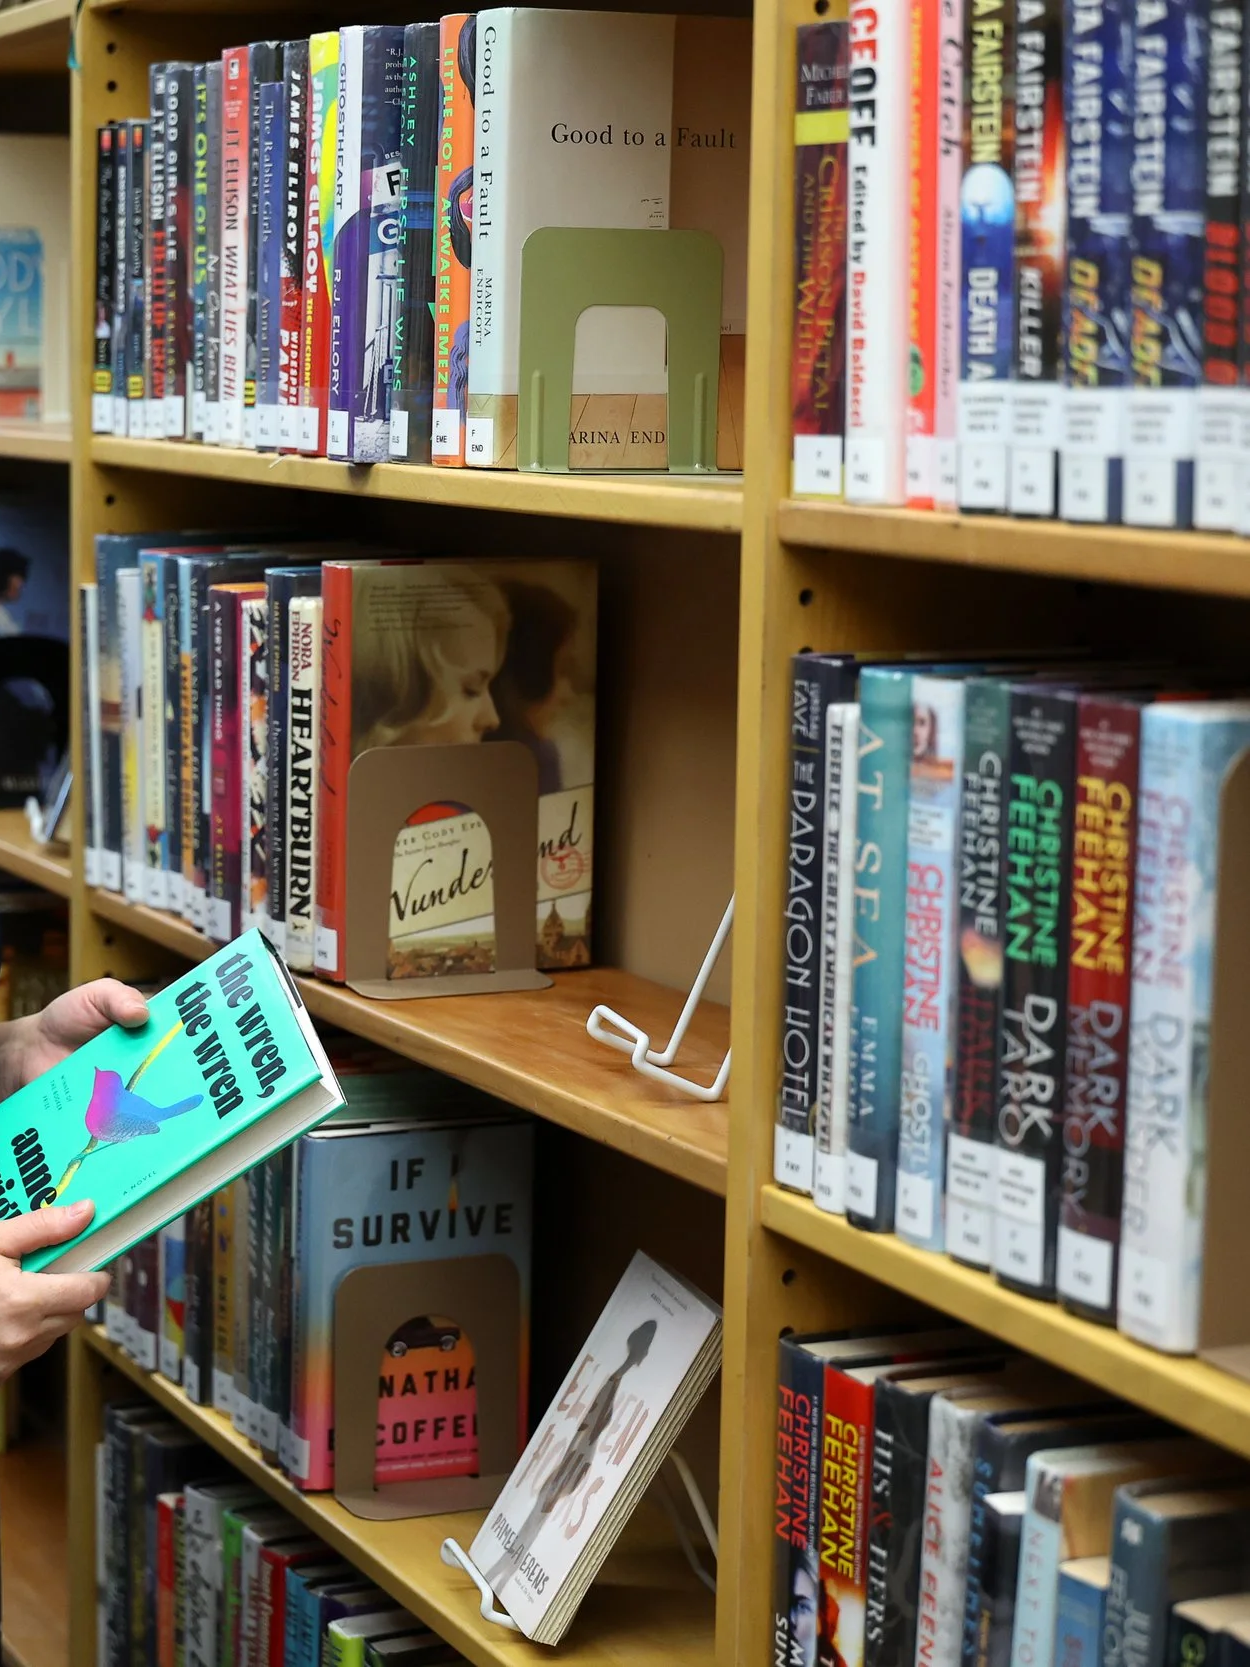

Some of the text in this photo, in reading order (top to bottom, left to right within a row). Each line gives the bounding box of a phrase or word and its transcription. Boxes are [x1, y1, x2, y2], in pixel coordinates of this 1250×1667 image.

[194, 83, 207, 124] IT'S
[335, 62, 347, 210] GHOSTHEART
[406, 56, 417, 147] ASHLEY
[477, 26, 498, 241] Good to a Fault
[550, 122, 737, 149] Good to a Fault
[971, 19, 1004, 163] FAIRSTEIN
[1014, 30, 1045, 202] FAIRSTEIN
[1070, 41, 1104, 218] FAIRSTEIN
[1131, 34, 1168, 216] FAIRSTEIN
[1206, 7, 1242, 197] FAIRSTEIN
[150, 106, 165, 221] J.T. ELLISON
[164, 80, 180, 262] GOOD GIRLS LIE
[194, 133, 208, 196] ONE
[260, 100, 274, 242] The Rabbit Girls
[286, 71, 301, 256] JAMES ELLROY
[437, 48, 455, 394] LITTLE ROT AKWAEKE EMEZI
[193, 246, 208, 285] US
[222, 129, 239, 400] J.T. ELLISON WHAT LIES BEHI
[259, 298, 270, 341] Anna
[329, 267, 342, 397] R.J. ELLORY
[392, 168, 409, 392] FIRST LIE WINS
[474, 267, 484, 346] ENDICOTT
[483, 276, 493, 339] MARINA
[814, 155, 840, 409] CRIMSON PETAL
[850, 165, 867, 428] Edited by David Baldacci
[968, 266, 998, 355] DEATH
[1018, 266, 1043, 377] KILLER
[436, 435, 448, 444] EME
[471, 444, 484, 453] END
[214, 616, 223, 652] VERY
[214, 657, 223, 690] BAD
[291, 610, 301, 683] EPHRON
[300, 622, 312, 673] NORA
[213, 694, 223, 742] THING
[290, 687, 312, 920] HEARTBURN
[827, 829, 841, 865] THE
[850, 720, 884, 969] AT SEA
[959, 771, 982, 909] FEEHAN
[973, 750, 1002, 938] CHRISTINE
[1005, 773, 1040, 963] FEEHAN
[1070, 775, 1107, 971] FEEHAN
[825, 871, 839, 938] GREAT
[1030, 778, 1064, 969] CHRISTINE
[1096, 781, 1132, 976] CHRISTINE
[822, 946, 837, 1046] AMERICAN
[916, 863, 945, 1032] CHRISTINE
[175, 980, 246, 1120] the wren
[214, 952, 288, 1099] the wren,
[781, 1005, 811, 1128] HOTEL
[860, 1015, 878, 1118] EMMA
[1022, 993, 1058, 1139] DARK
[1085, 999, 1123, 1138] DARK
[1146, 1011, 1184, 1158] DARK
[10, 1127, 58, 1212] anne
[129, 1170, 158, 1190] NOVEL
[390, 1157, 425, 1191] IF
[1061, 1004, 1092, 1220] MEMORY
[333, 1203, 515, 1250] SURVIVE
[775, 1382, 794, 1541] FEEHAN
[790, 1394, 812, 1550] CHRISTINE
[808, 1473, 817, 1523] BESTSELLING
[820, 1412, 844, 1569] FEEHAN
[836, 1422, 859, 1579] CHRISTINE
[923, 1457, 945, 1559] ALICE
[490, 1512, 525, 1565] PAMELA
[518, 1551, 550, 1596] ERENS
[867, 1428, 894, 1646] HIS & HERS
